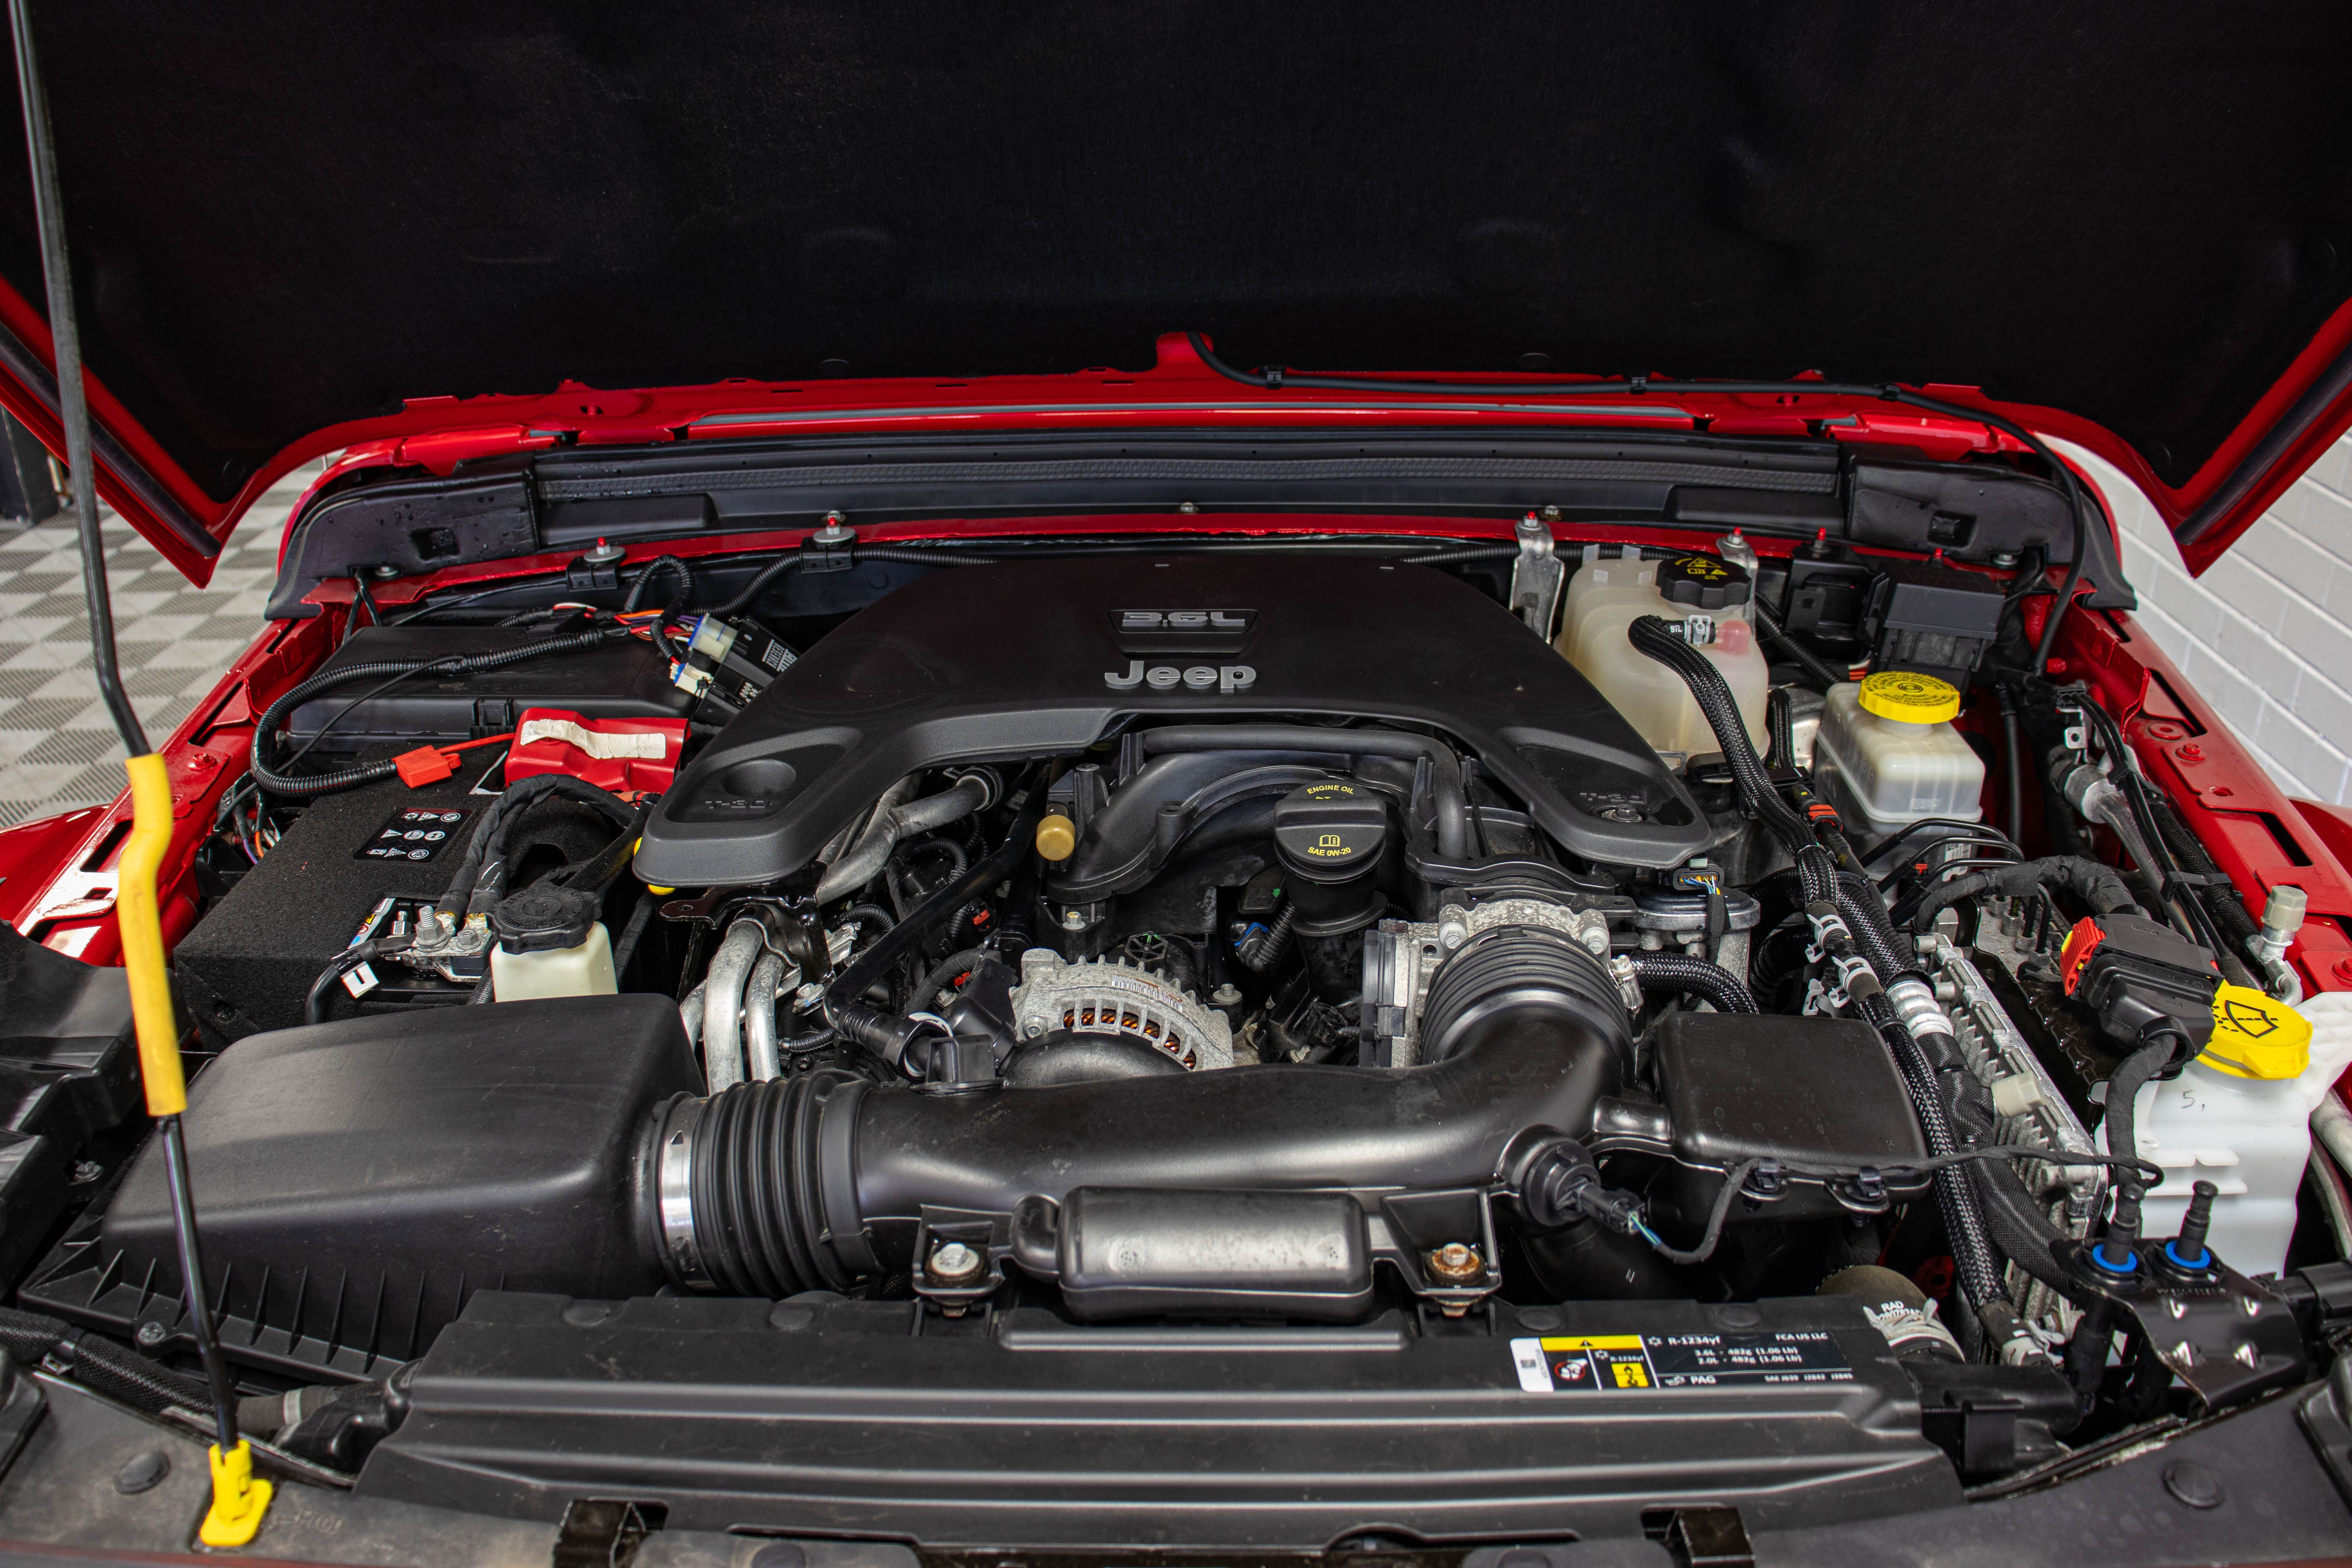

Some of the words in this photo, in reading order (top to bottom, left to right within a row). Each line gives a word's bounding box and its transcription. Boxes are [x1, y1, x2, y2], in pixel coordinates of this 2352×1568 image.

[1122, 611, 1245, 627] 3.6L
[1670, 625, 1682, 633] BTL
[1105, 660, 1256, 693] Jeep
[1307, 785, 1340, 794] ENGINE
[1341, 786, 1354, 794] OIL
[1308, 846, 1325, 856] SAE
[1327, 847, 1351, 856] 0W-20
[1880, 1300, 1904, 1312] RAD
[1668, 1335, 1721, 1345] R-1234yf
[1775, 1333, 1795, 1341] FCA
[1795, 1332, 1810, 1341] US
[1811, 1332, 1829, 1340] LLC
[1690, 1374, 1717, 1385] PAG
